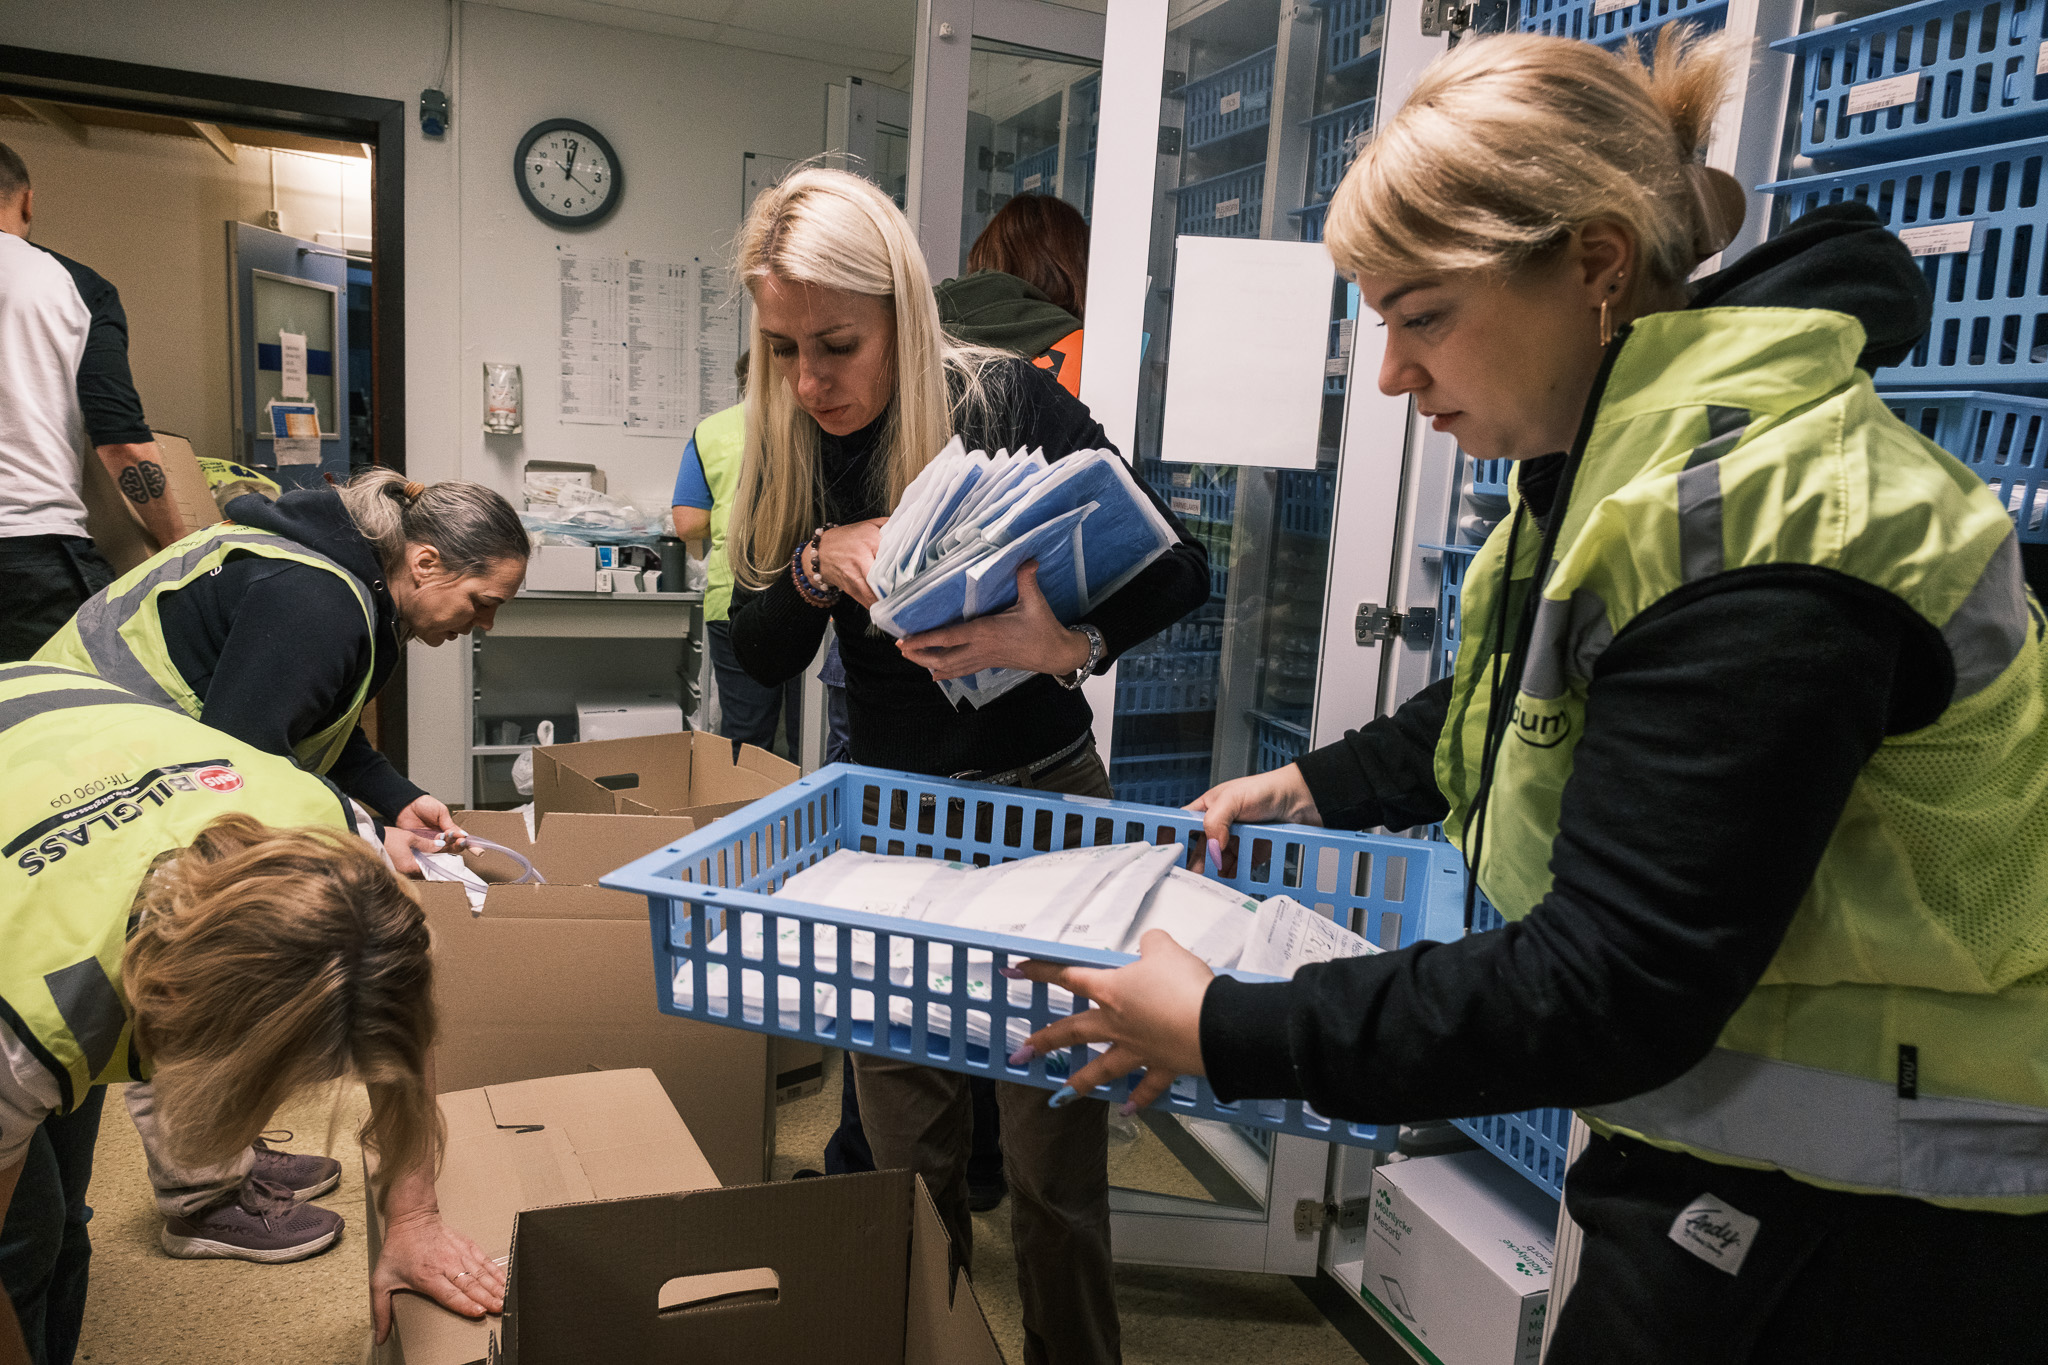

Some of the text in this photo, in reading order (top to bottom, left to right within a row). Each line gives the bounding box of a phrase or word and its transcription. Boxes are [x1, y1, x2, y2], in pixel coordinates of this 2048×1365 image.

[562, 138, 577, 150] 12
[539, 151, 548, 159] 10
[534, 164, 543, 175] 9
[594, 172, 602, 183] 3
[540, 181, 546, 189] 8
[563, 197, 572, 209] 6
[74, 779, 106, 799] 090
[50, 793, 72, 809] 09
[62, 786, 140, 819] www.bilglass.no
[18, 774, 199, 876] BILGLASS
[1375, 1199, 1413, 1235] Mölnlycke
[1373, 1212, 1402, 1241] Mesorb
[1502, 1238, 1548, 1276] Mölnlycke
[1526, 1244, 1553, 1269] esorb
